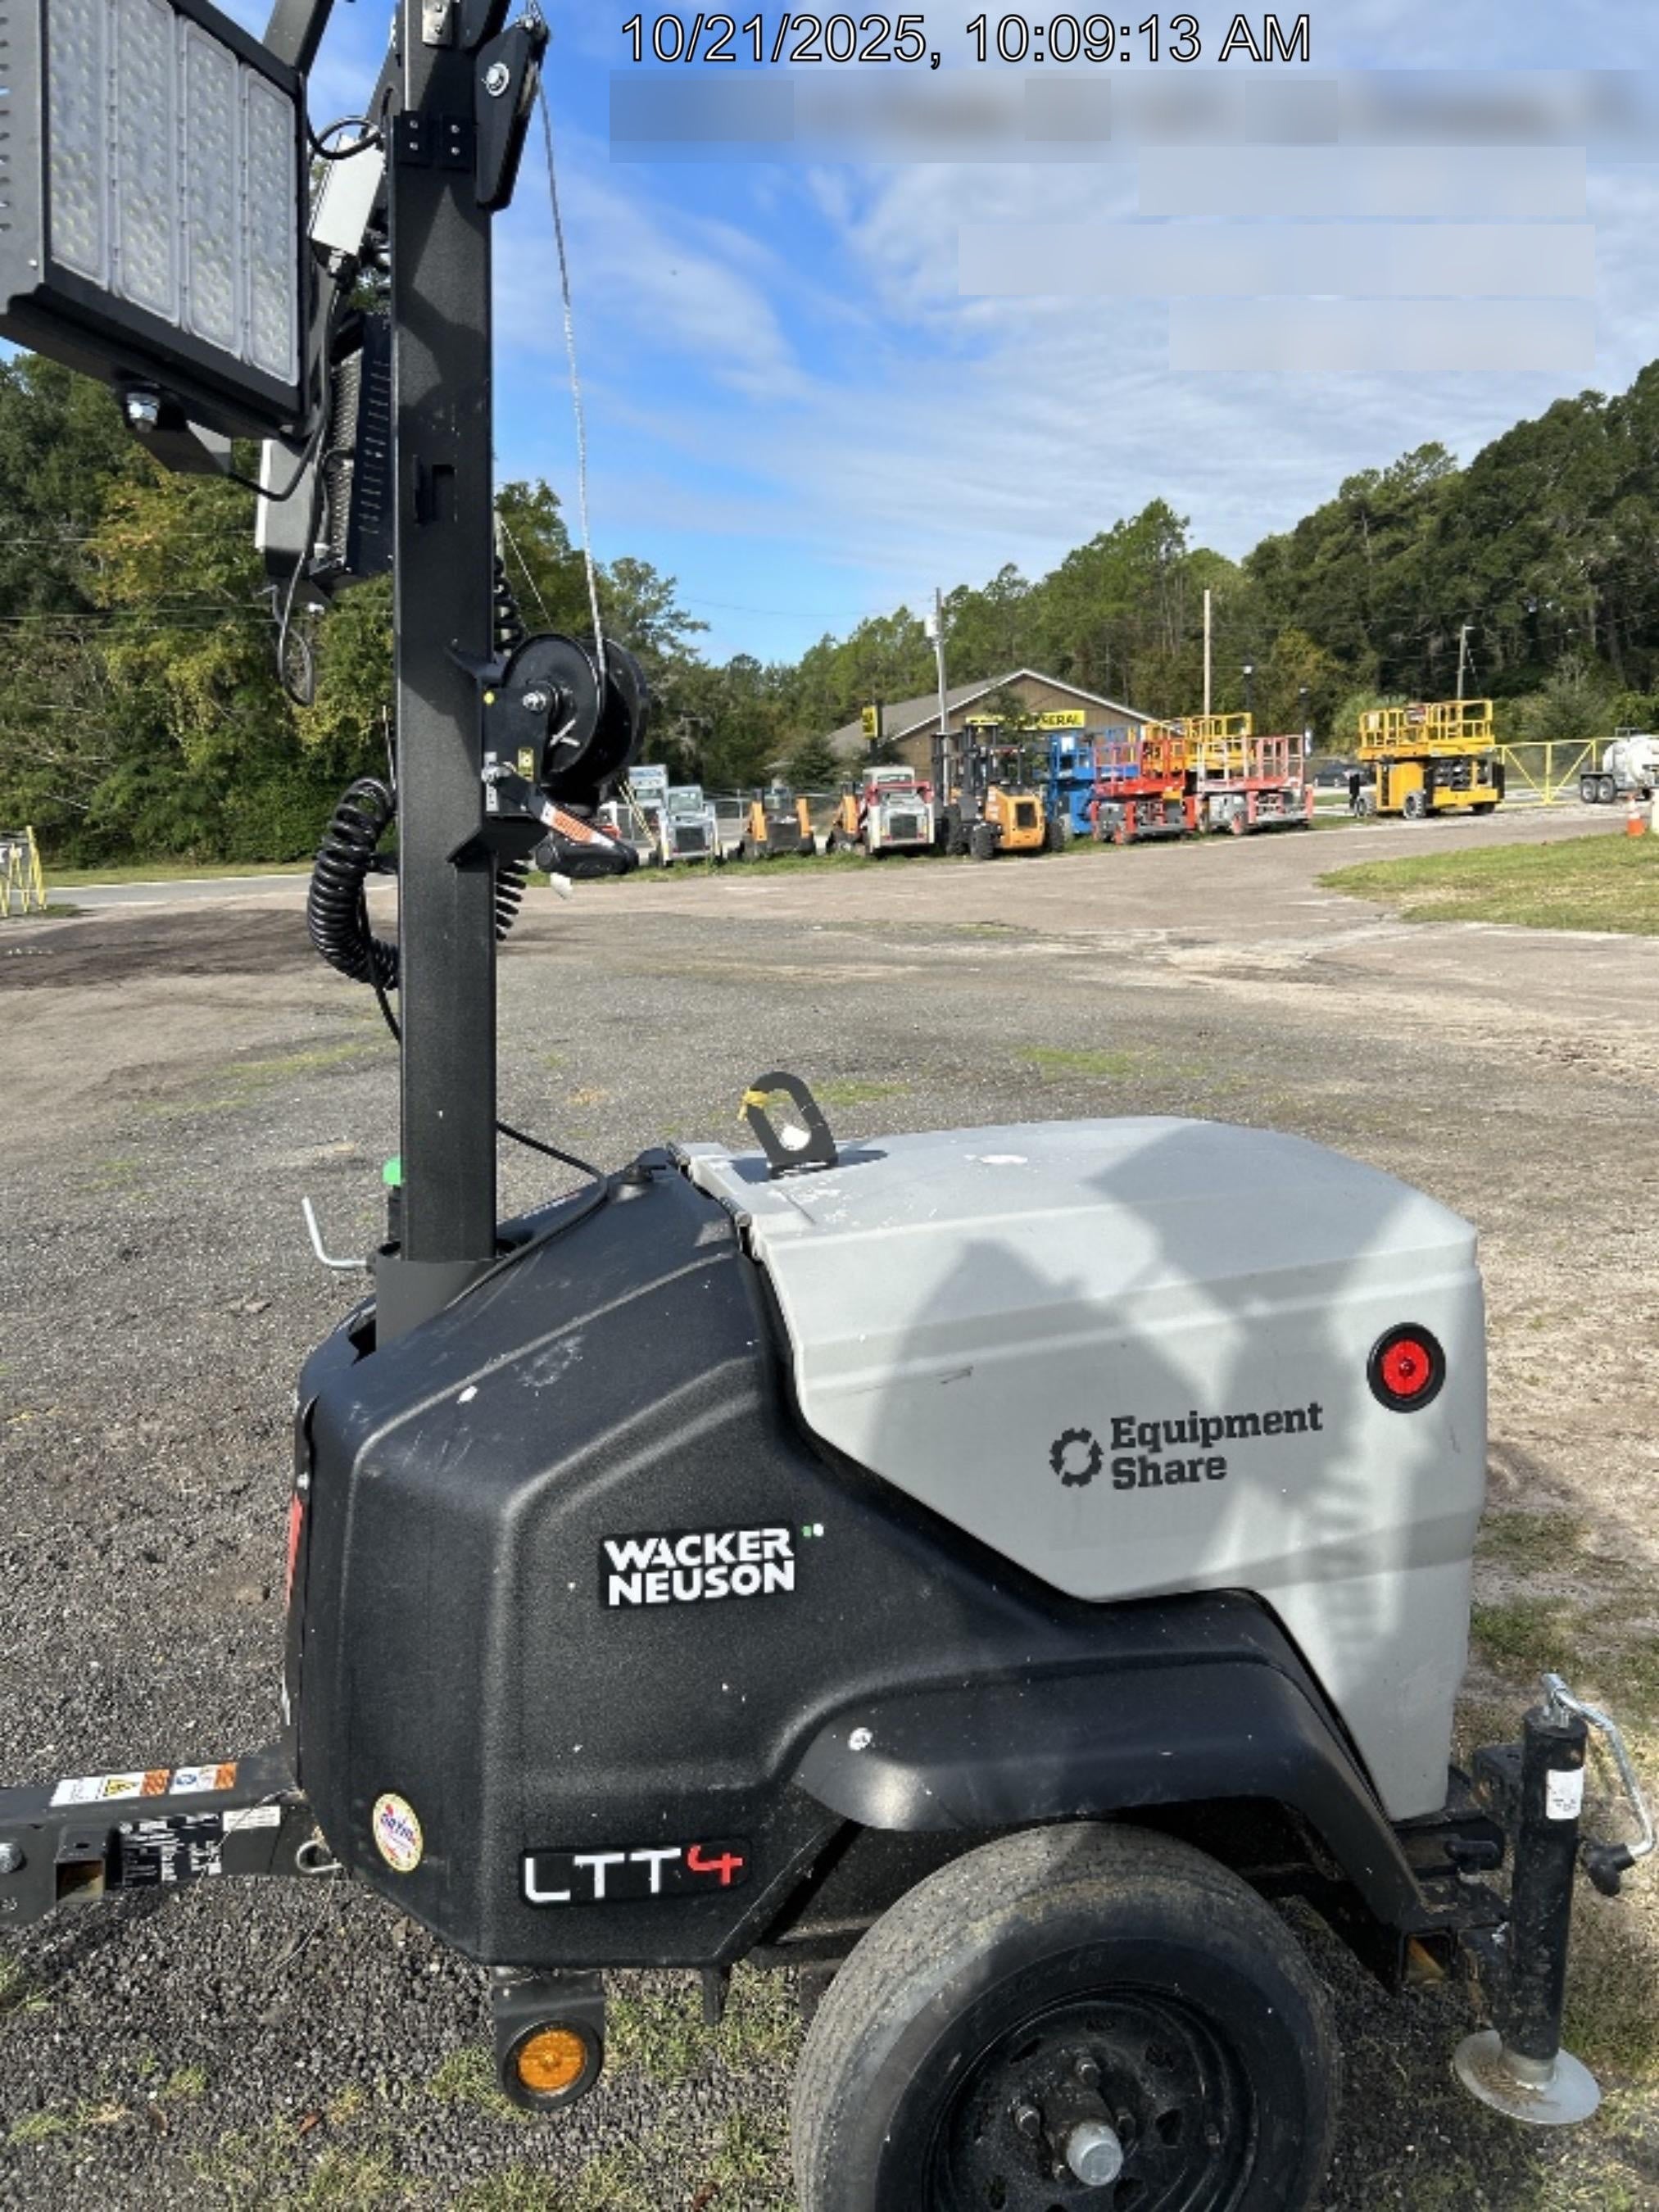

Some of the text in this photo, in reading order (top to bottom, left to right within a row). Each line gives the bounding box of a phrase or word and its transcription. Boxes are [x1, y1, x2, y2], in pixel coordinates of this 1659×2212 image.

[1110, 1401, 1324, 1453] Equipment
[1111, 1455, 1228, 1490] Share
[603, 1527, 796, 1572] WACKER
[608, 1559, 796, 1607] NEUSON
